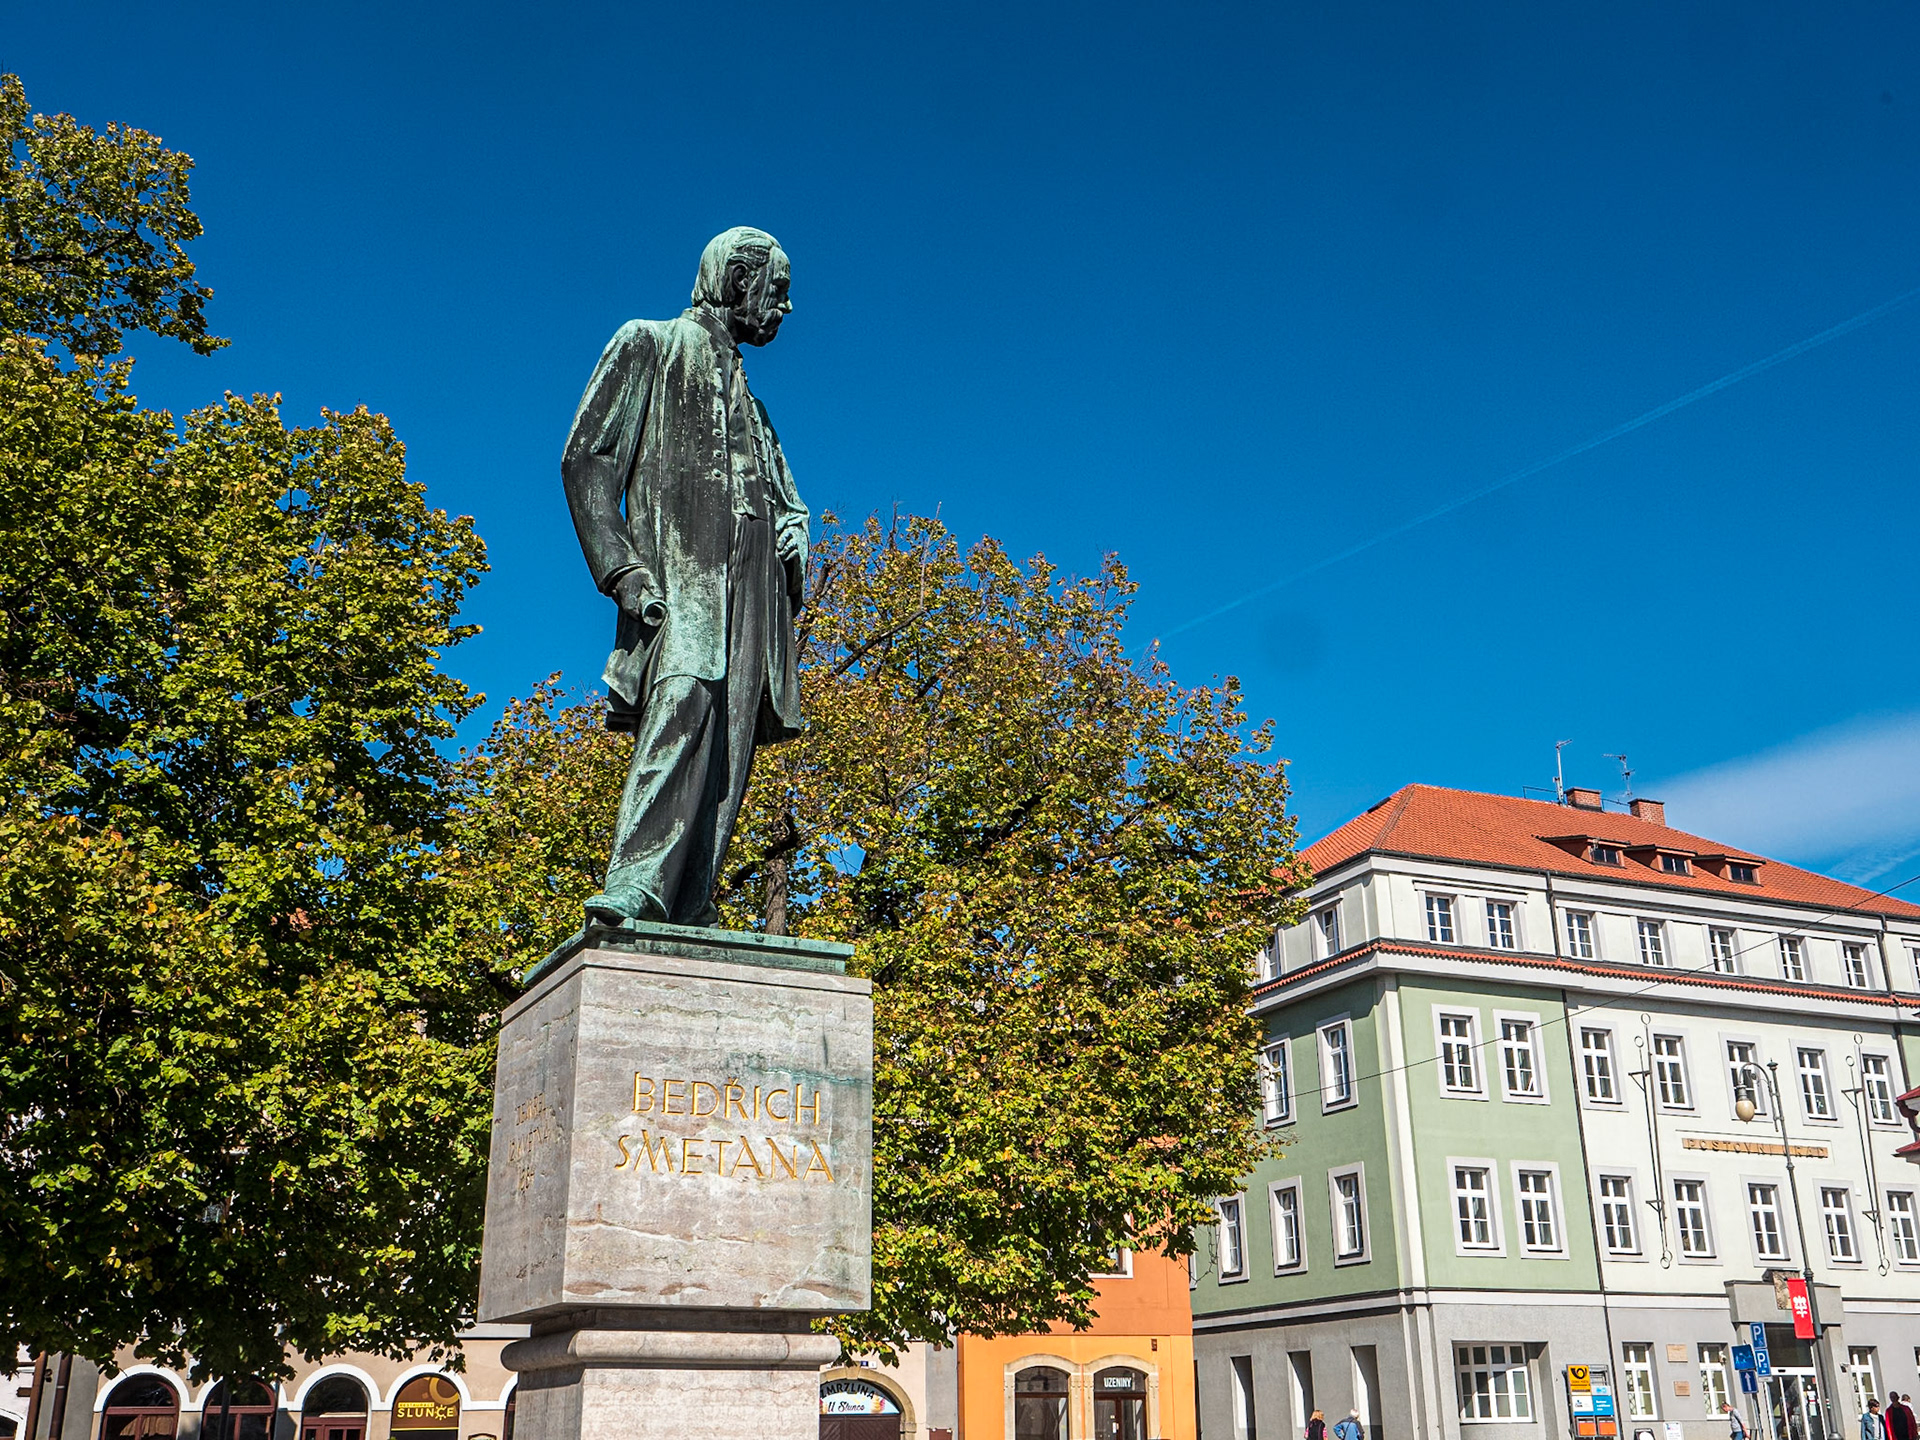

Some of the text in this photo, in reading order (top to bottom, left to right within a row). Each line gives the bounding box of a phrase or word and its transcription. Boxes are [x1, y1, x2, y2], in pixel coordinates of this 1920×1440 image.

[632, 1071, 821, 1125] BEDŘICH
[614, 1129, 835, 1183] SMETANA
[1752, 1325, 1762, 1341] P
[1757, 1352, 1766, 1368] P
[1103, 1377, 1132, 1388] UZENINY
[821, 1382, 876, 1400] ZMRZLINA
[397, 1406, 454, 1419] SLUNCE
